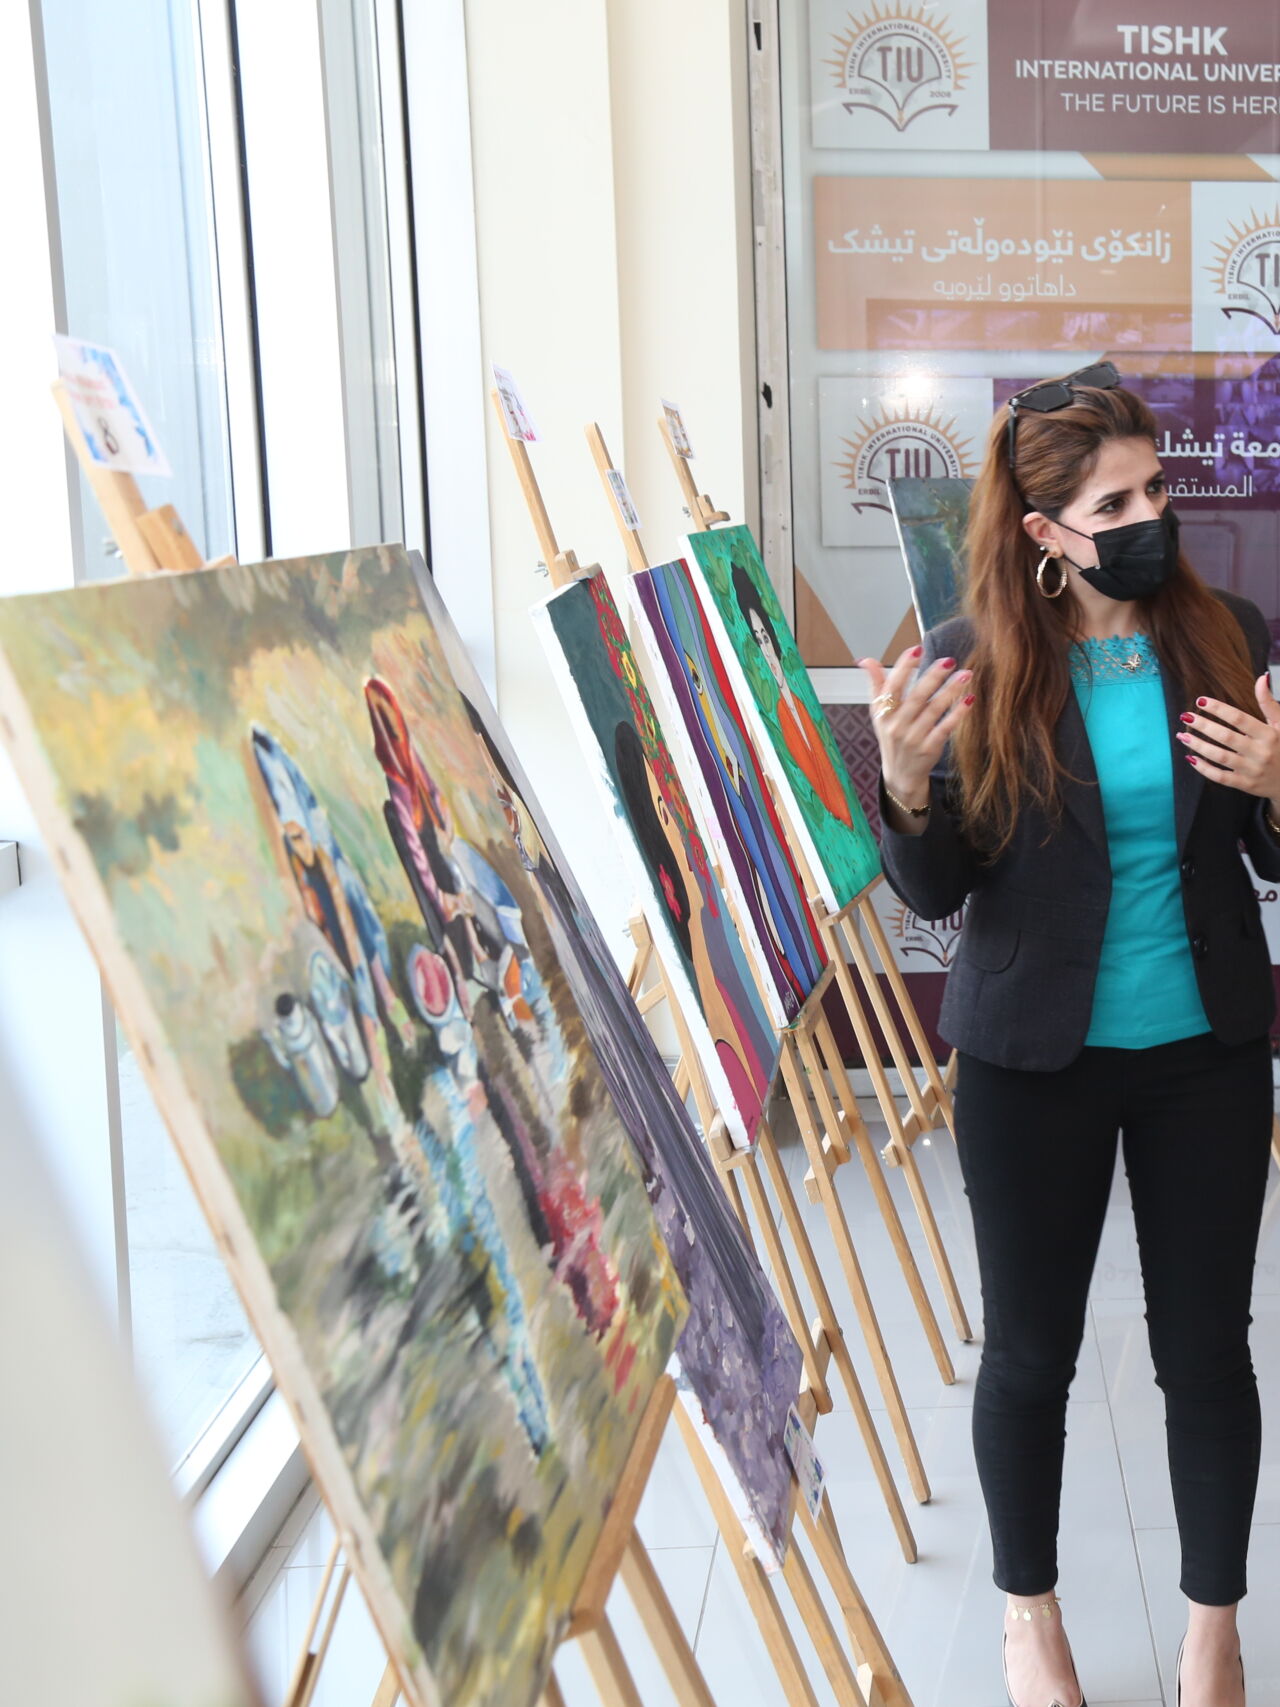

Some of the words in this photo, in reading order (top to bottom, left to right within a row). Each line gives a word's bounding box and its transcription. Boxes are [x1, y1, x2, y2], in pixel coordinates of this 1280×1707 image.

[855, 23, 920, 50] INTERNATIONAL
[1116, 24, 1229, 56] TISHK
[876, 46, 924, 83] TIU
[1015, 59, 1199, 81] INTERNATIONAL
[1060, 93, 1105, 112] THE
[1112, 94, 1201, 114] FUTURE
[1207, 95, 1226, 114] IS
[867, 426, 928, 453] INTERNATIONAL
[885, 448, 931, 478] TIU
[1168, 475, 1252, 502] المستقب
